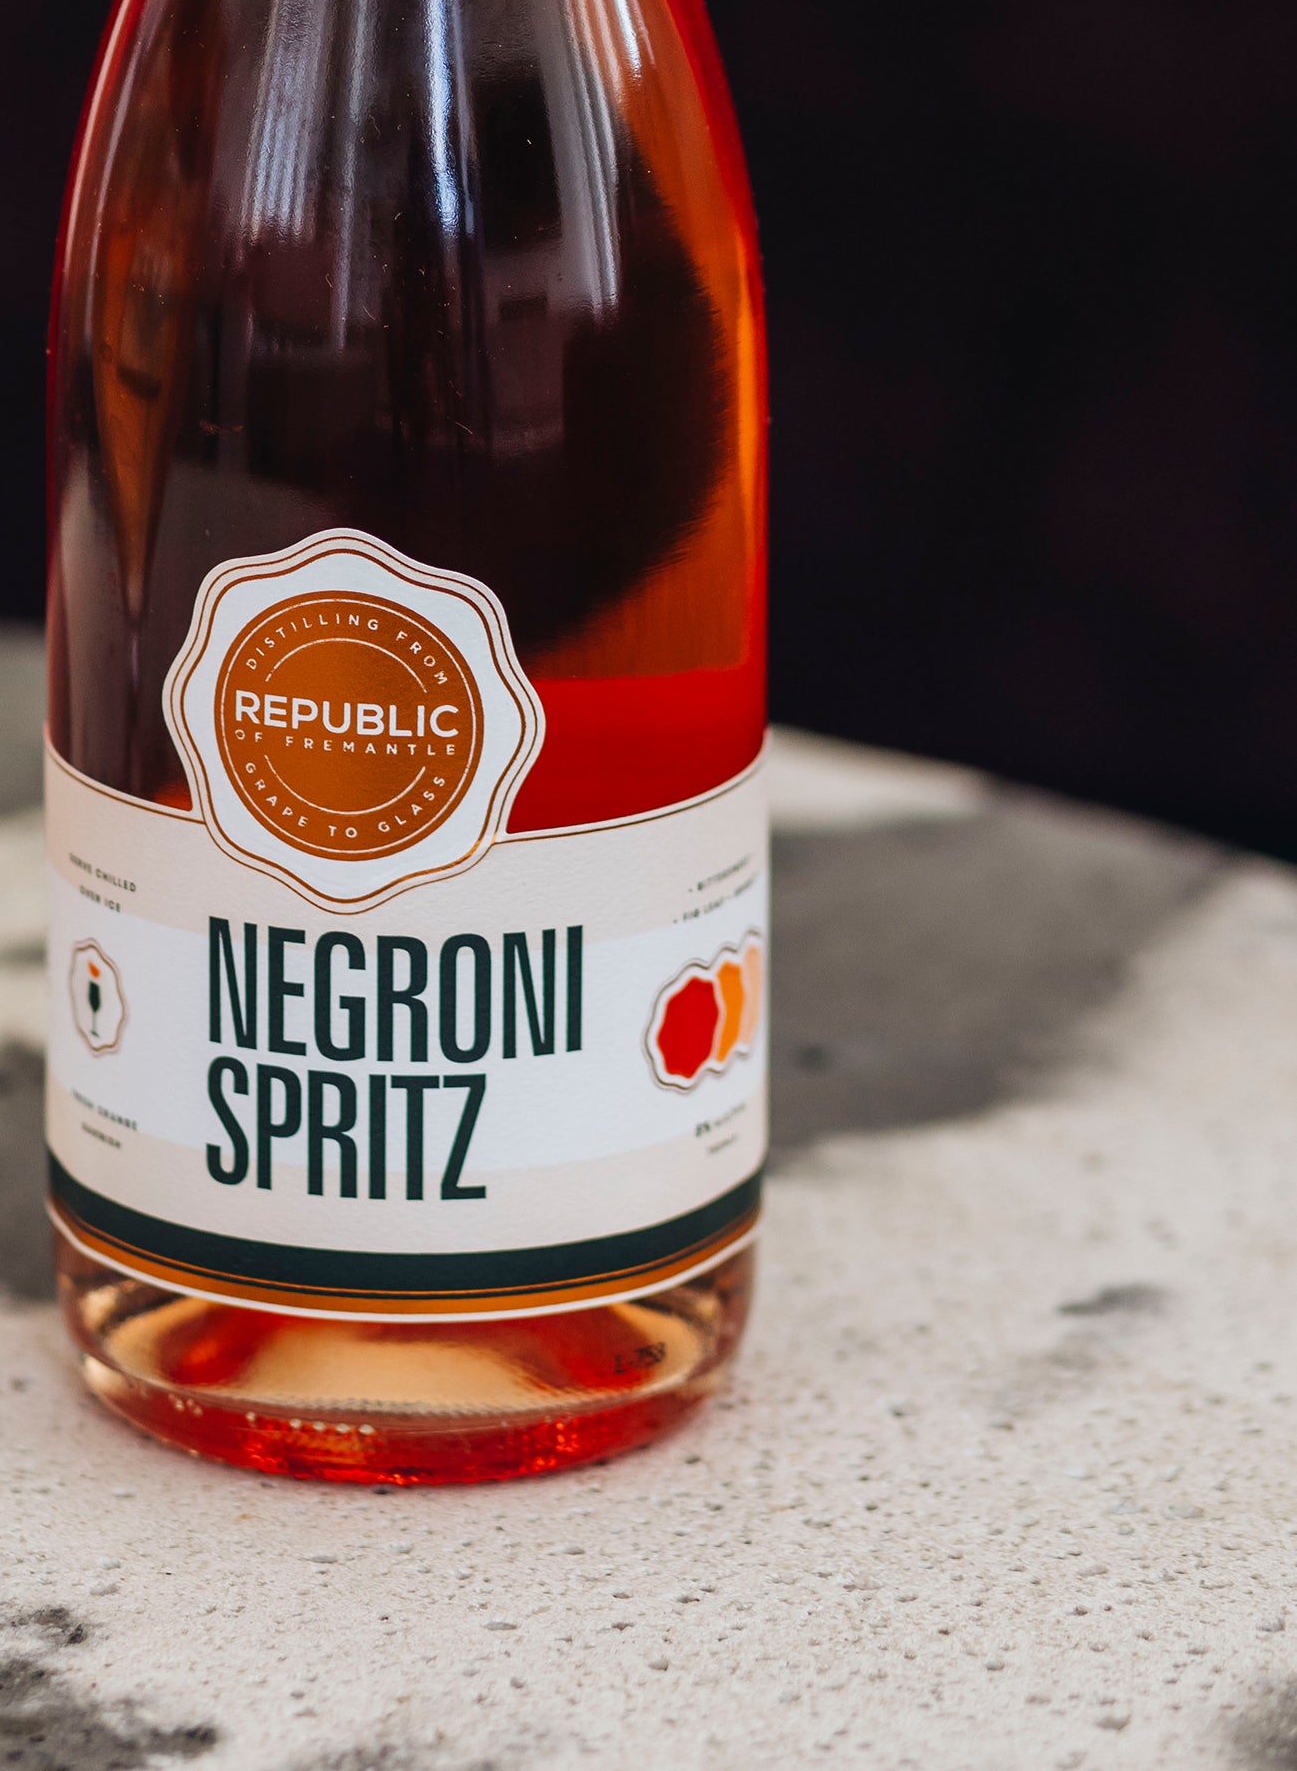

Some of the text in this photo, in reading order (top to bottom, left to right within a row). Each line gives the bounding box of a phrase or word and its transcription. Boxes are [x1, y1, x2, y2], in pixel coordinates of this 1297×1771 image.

[246, 614, 448, 685] DISTILLING FROM
[234, 729, 456, 756] OF FREMANTLE
[235, 689, 459, 738] REPUBLIC
[246, 762, 446, 839] GRAPE TO GLASS
[209, 916, 583, 1063] NEGRONI
[207, 1056, 487, 1201] SPRITZ
